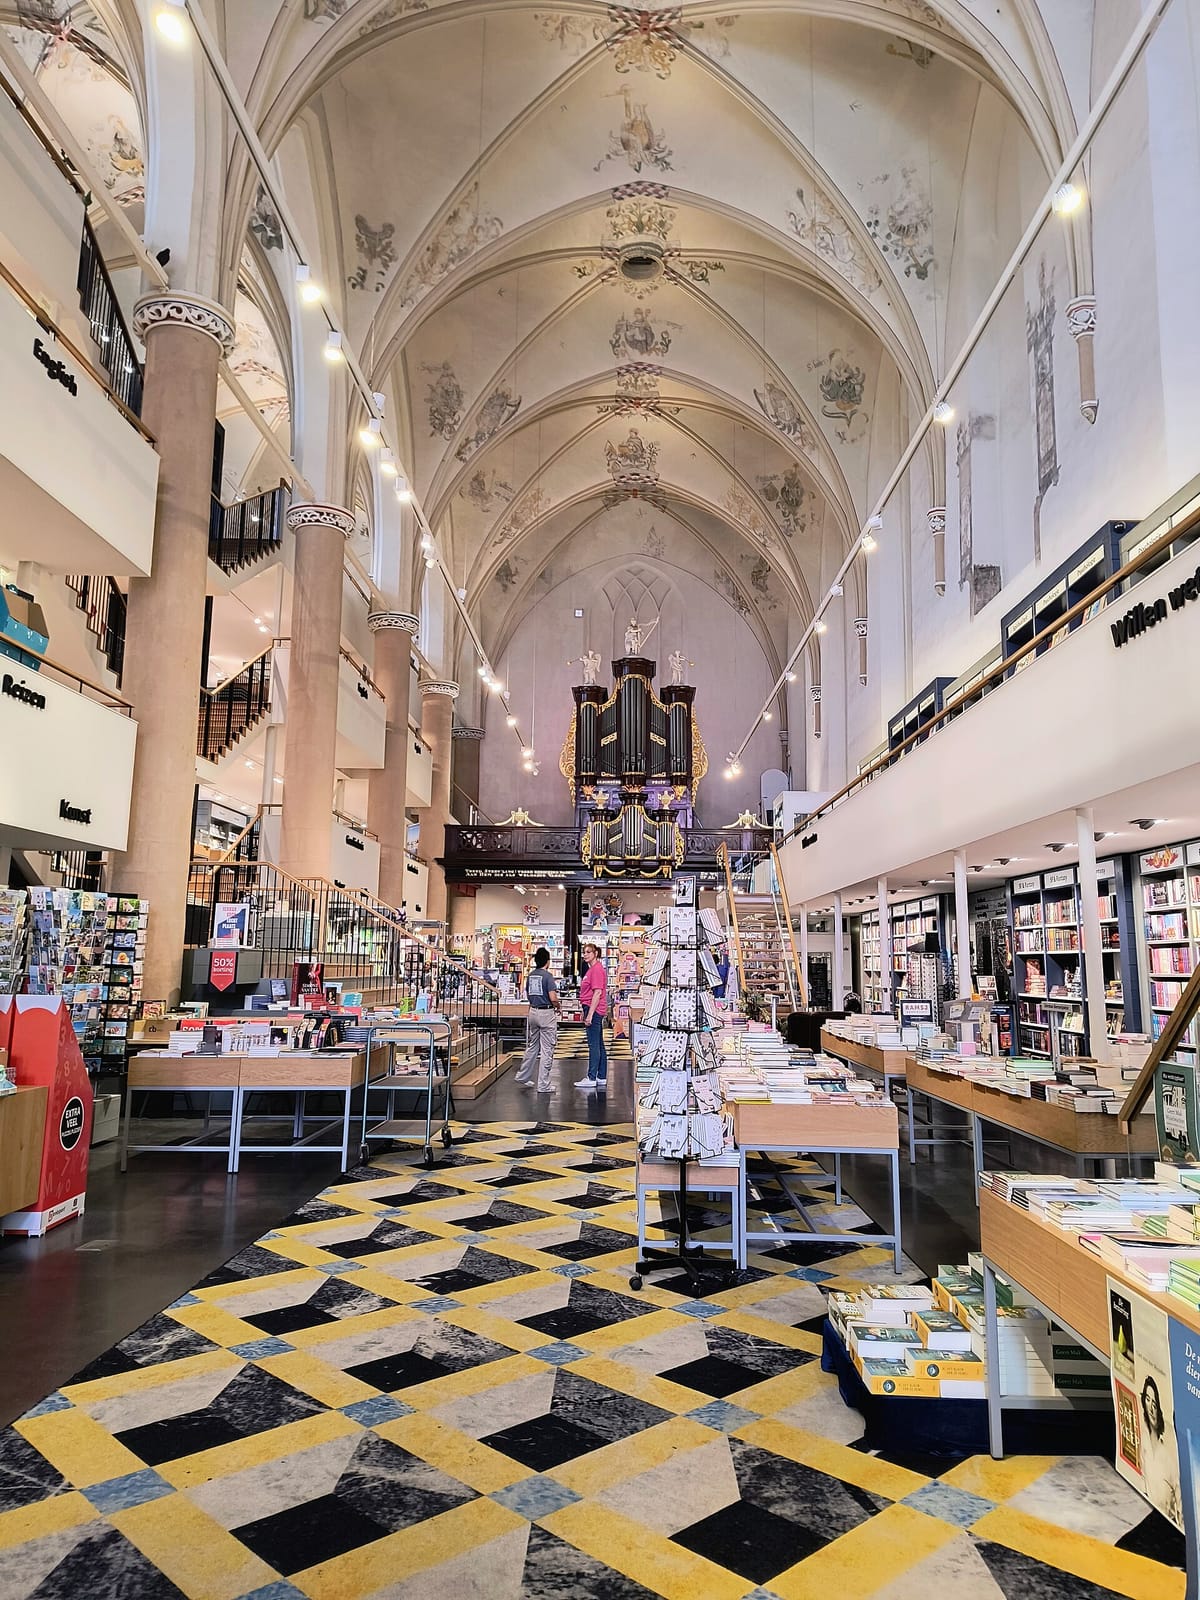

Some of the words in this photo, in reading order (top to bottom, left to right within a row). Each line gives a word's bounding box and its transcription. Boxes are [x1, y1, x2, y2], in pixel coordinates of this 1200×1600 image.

[33, 338, 77, 397] English
[1110, 598, 1168, 649] Willen
[2, 674, 46, 710] Reizen
[59, 799, 92, 824] Kunst
[213, 958, 233, 967] 50%
[65, 1107, 81, 1119] EXTRA
[66, 1117, 78, 1128] VEEL
[1185, 1342, 1196, 1361] De
